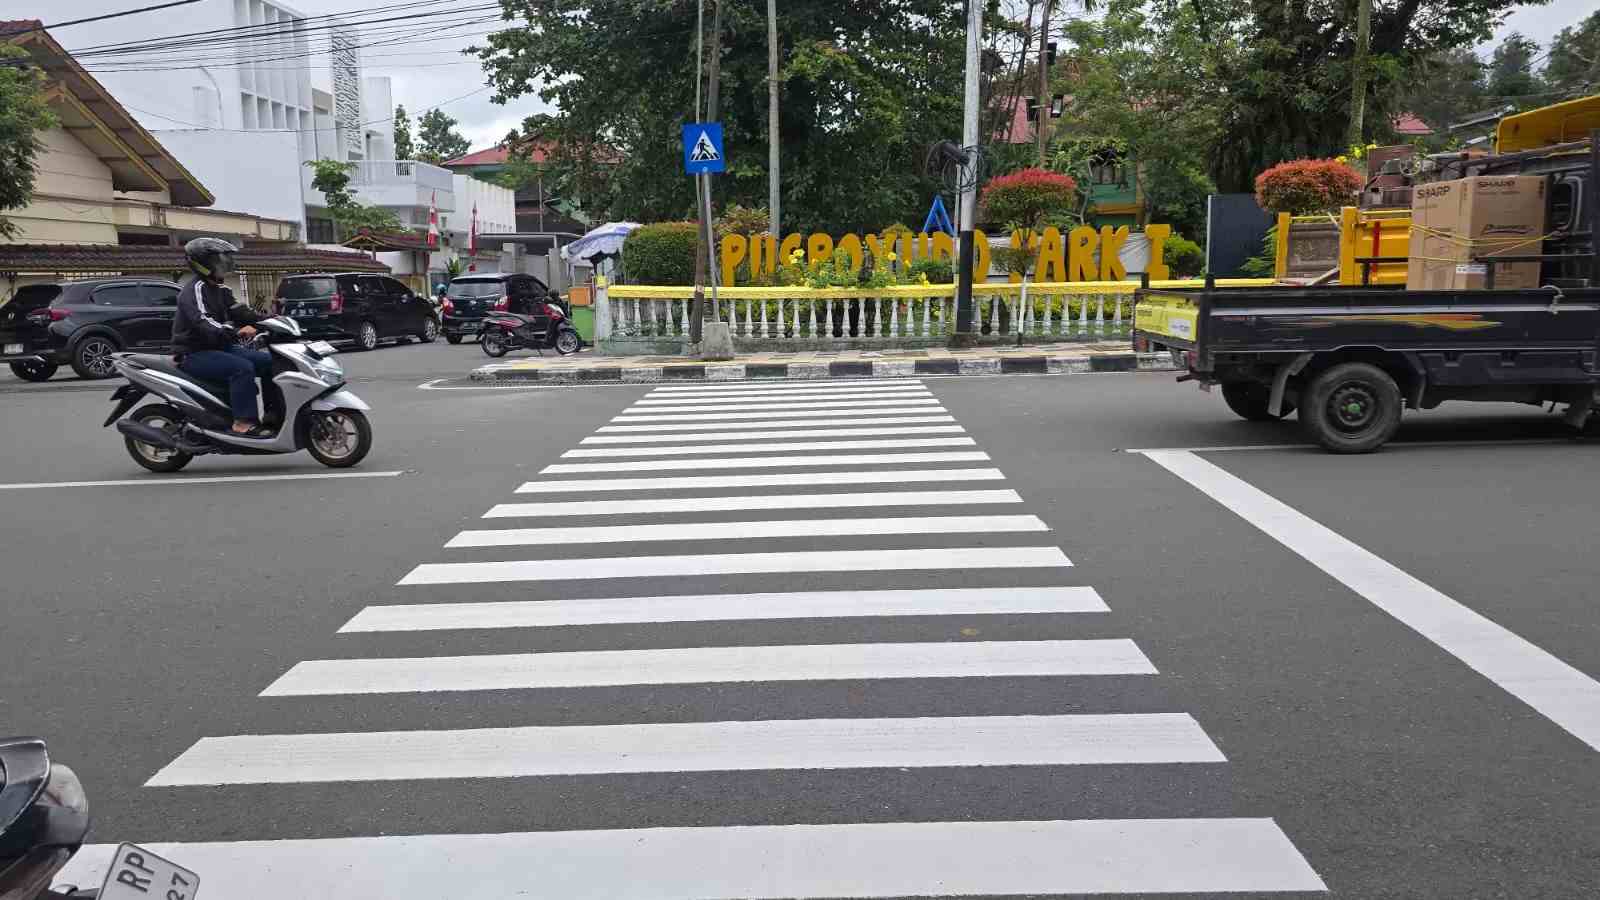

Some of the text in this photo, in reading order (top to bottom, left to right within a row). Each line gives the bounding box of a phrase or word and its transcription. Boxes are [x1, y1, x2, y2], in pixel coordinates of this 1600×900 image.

[1416, 185, 1451, 200] SHARP
[1145, 223, 1171, 281] I
[116, 852, 155, 893] RP
